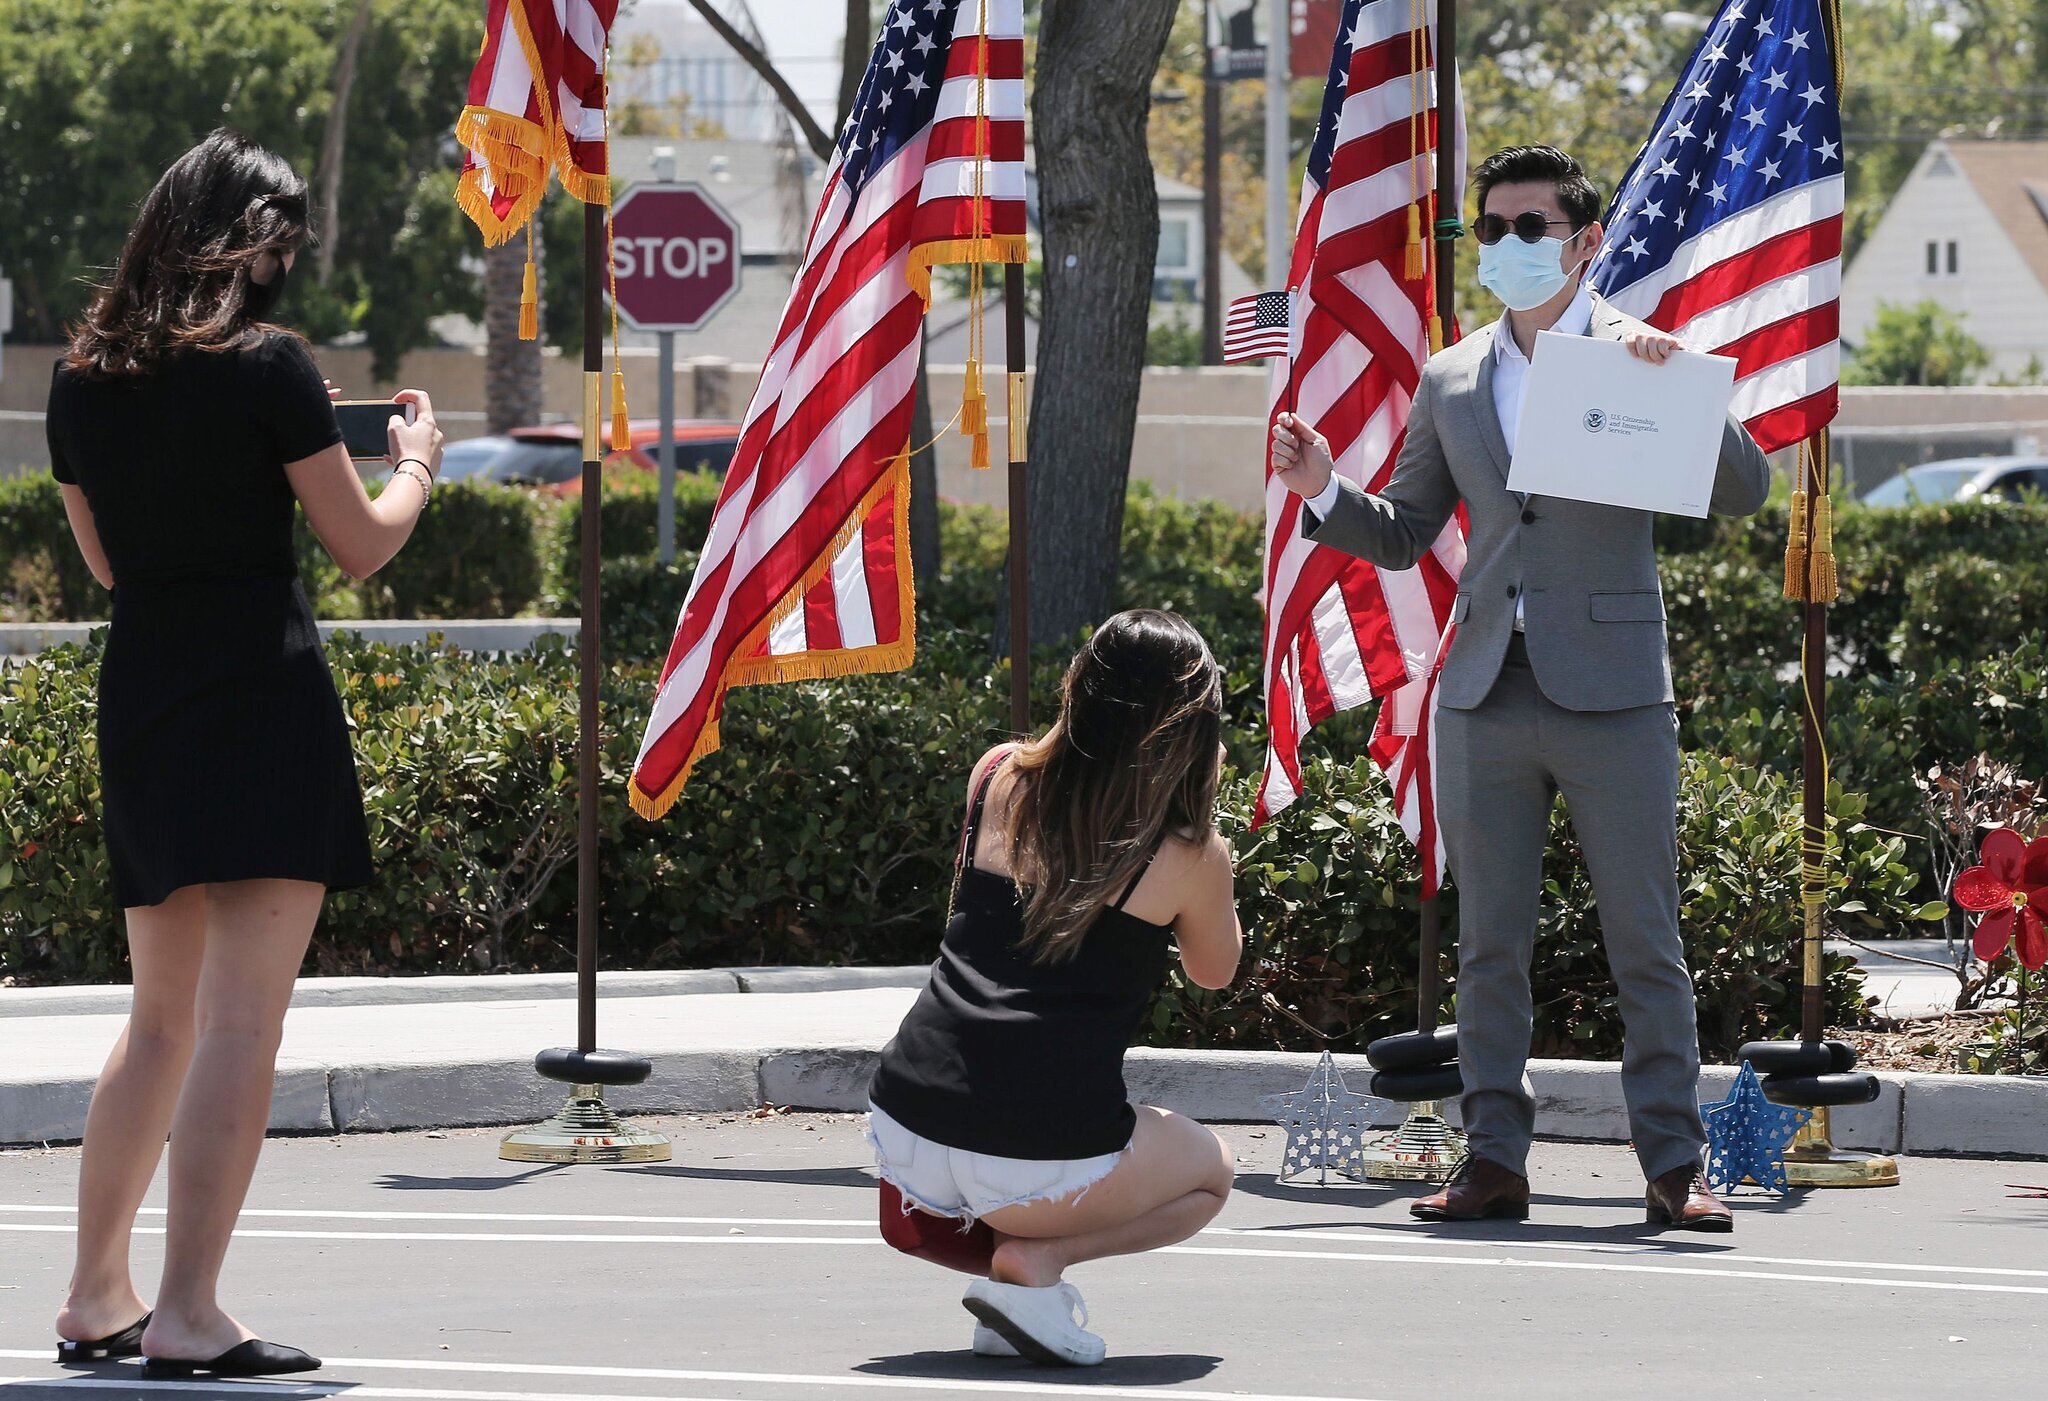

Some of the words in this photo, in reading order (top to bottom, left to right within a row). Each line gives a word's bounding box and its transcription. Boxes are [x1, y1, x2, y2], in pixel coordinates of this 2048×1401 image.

[606, 236, 727, 279] STOP
[1610, 413, 1621, 421] U.S.
[1622, 416, 1656, 428] Citizenship
[1608, 427, 1631, 435] Services
[1622, 422, 1659, 433] Immigration
